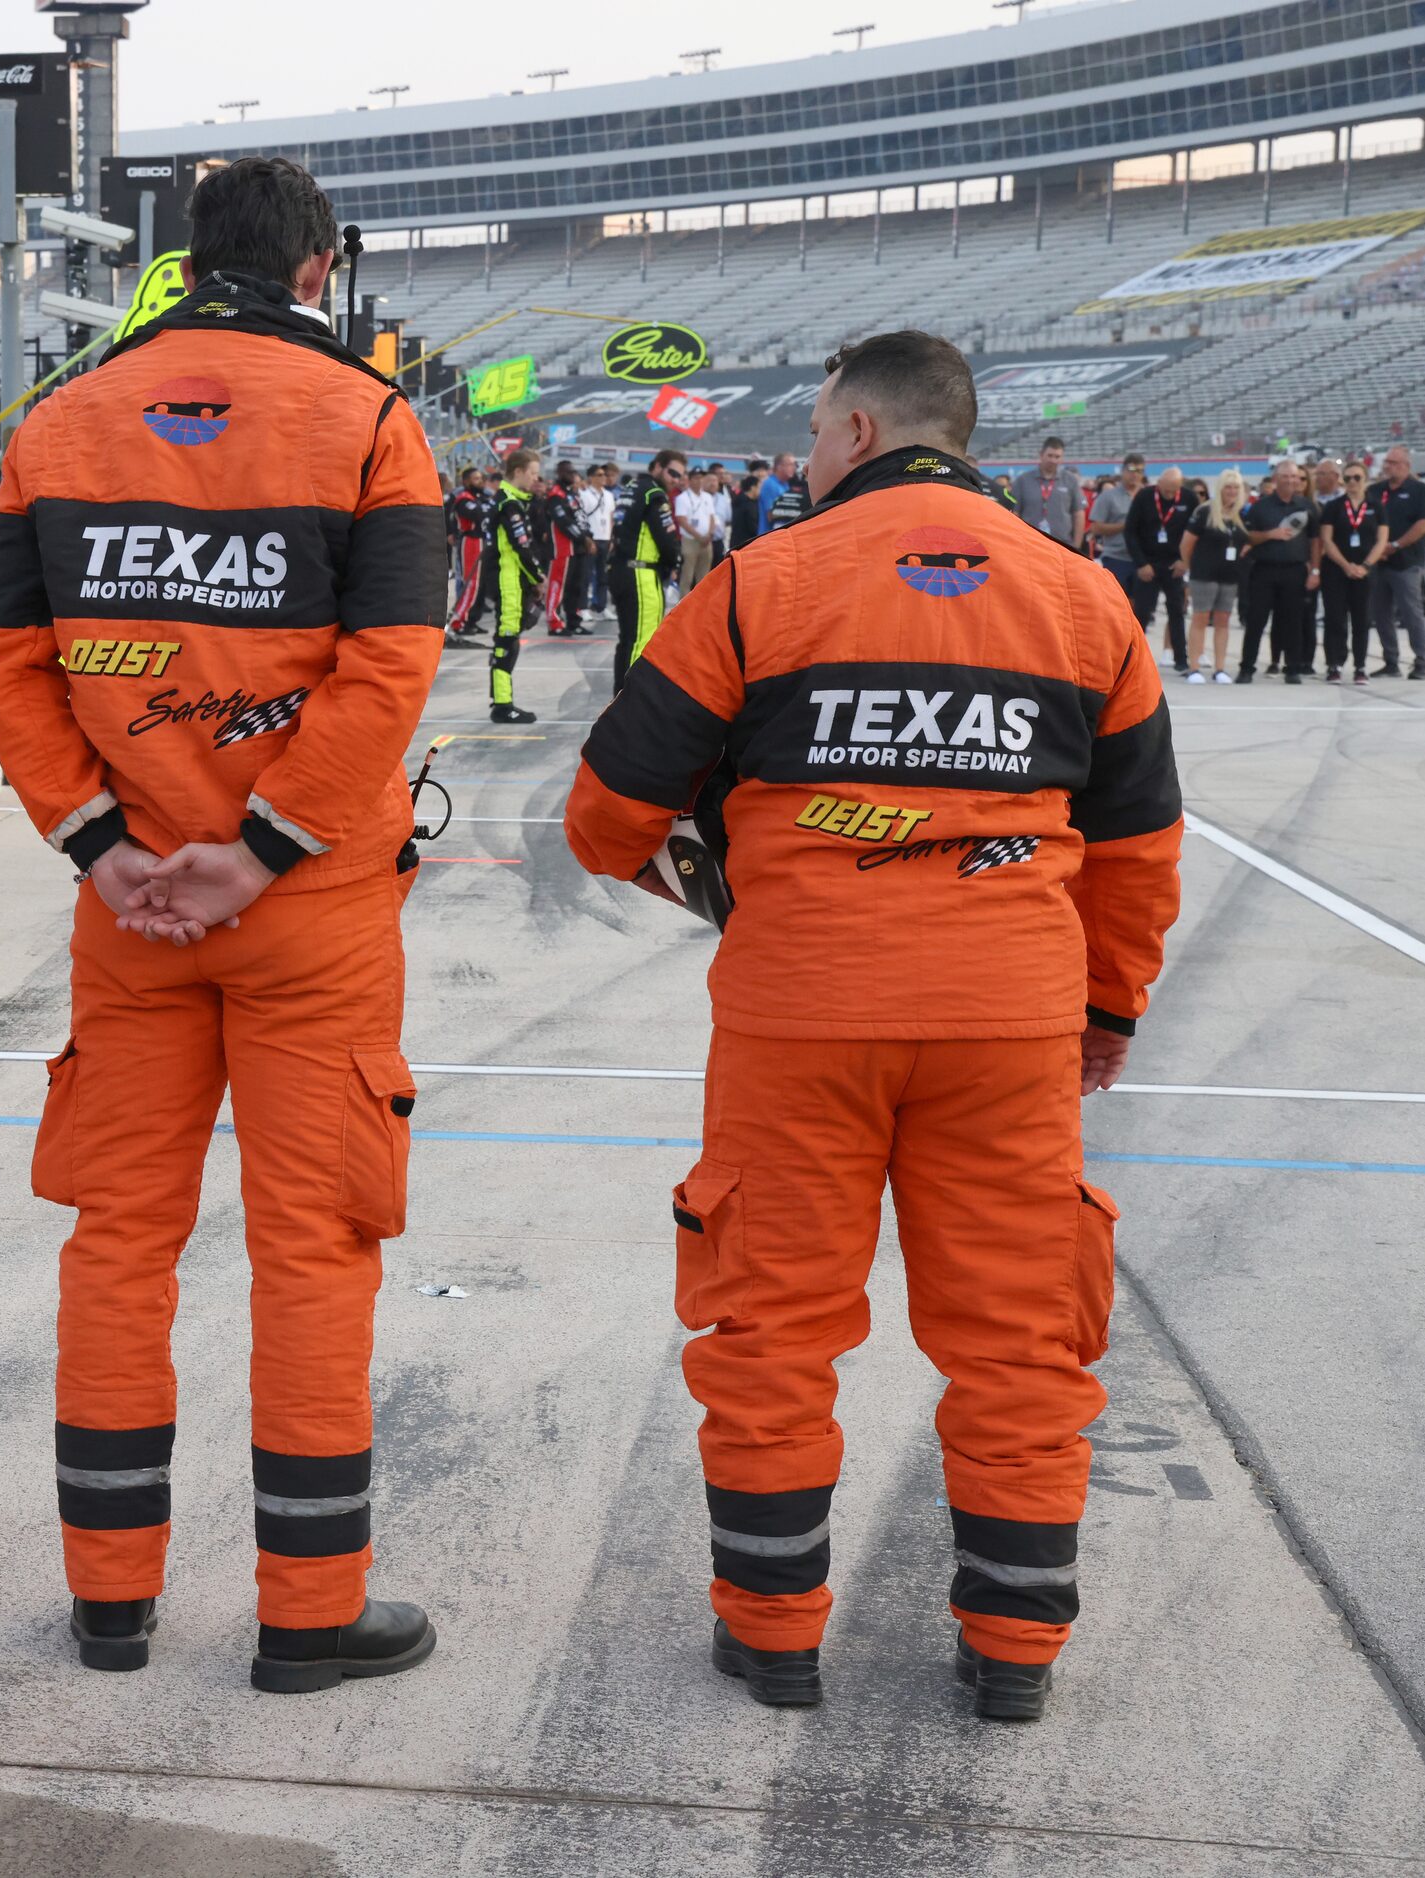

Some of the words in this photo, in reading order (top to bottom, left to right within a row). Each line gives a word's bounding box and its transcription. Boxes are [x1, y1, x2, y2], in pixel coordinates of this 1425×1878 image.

[126, 166, 172, 178] GEICO
[605, 329, 700, 378] Gates
[476, 360, 529, 408] 45
[82, 525, 287, 587] TEXAS
[79, 580, 158, 600] MOTOR
[162, 581, 286, 609] SPEEDWAY
[68, 638, 182, 678] DEIST
[128, 688, 257, 740] Safety
[809, 689, 1040, 751] TEXAS
[807, 746, 898, 767] MOTOR
[904, 748, 1032, 774] SPEEDWAY
[794, 794, 933, 843] DEIST
